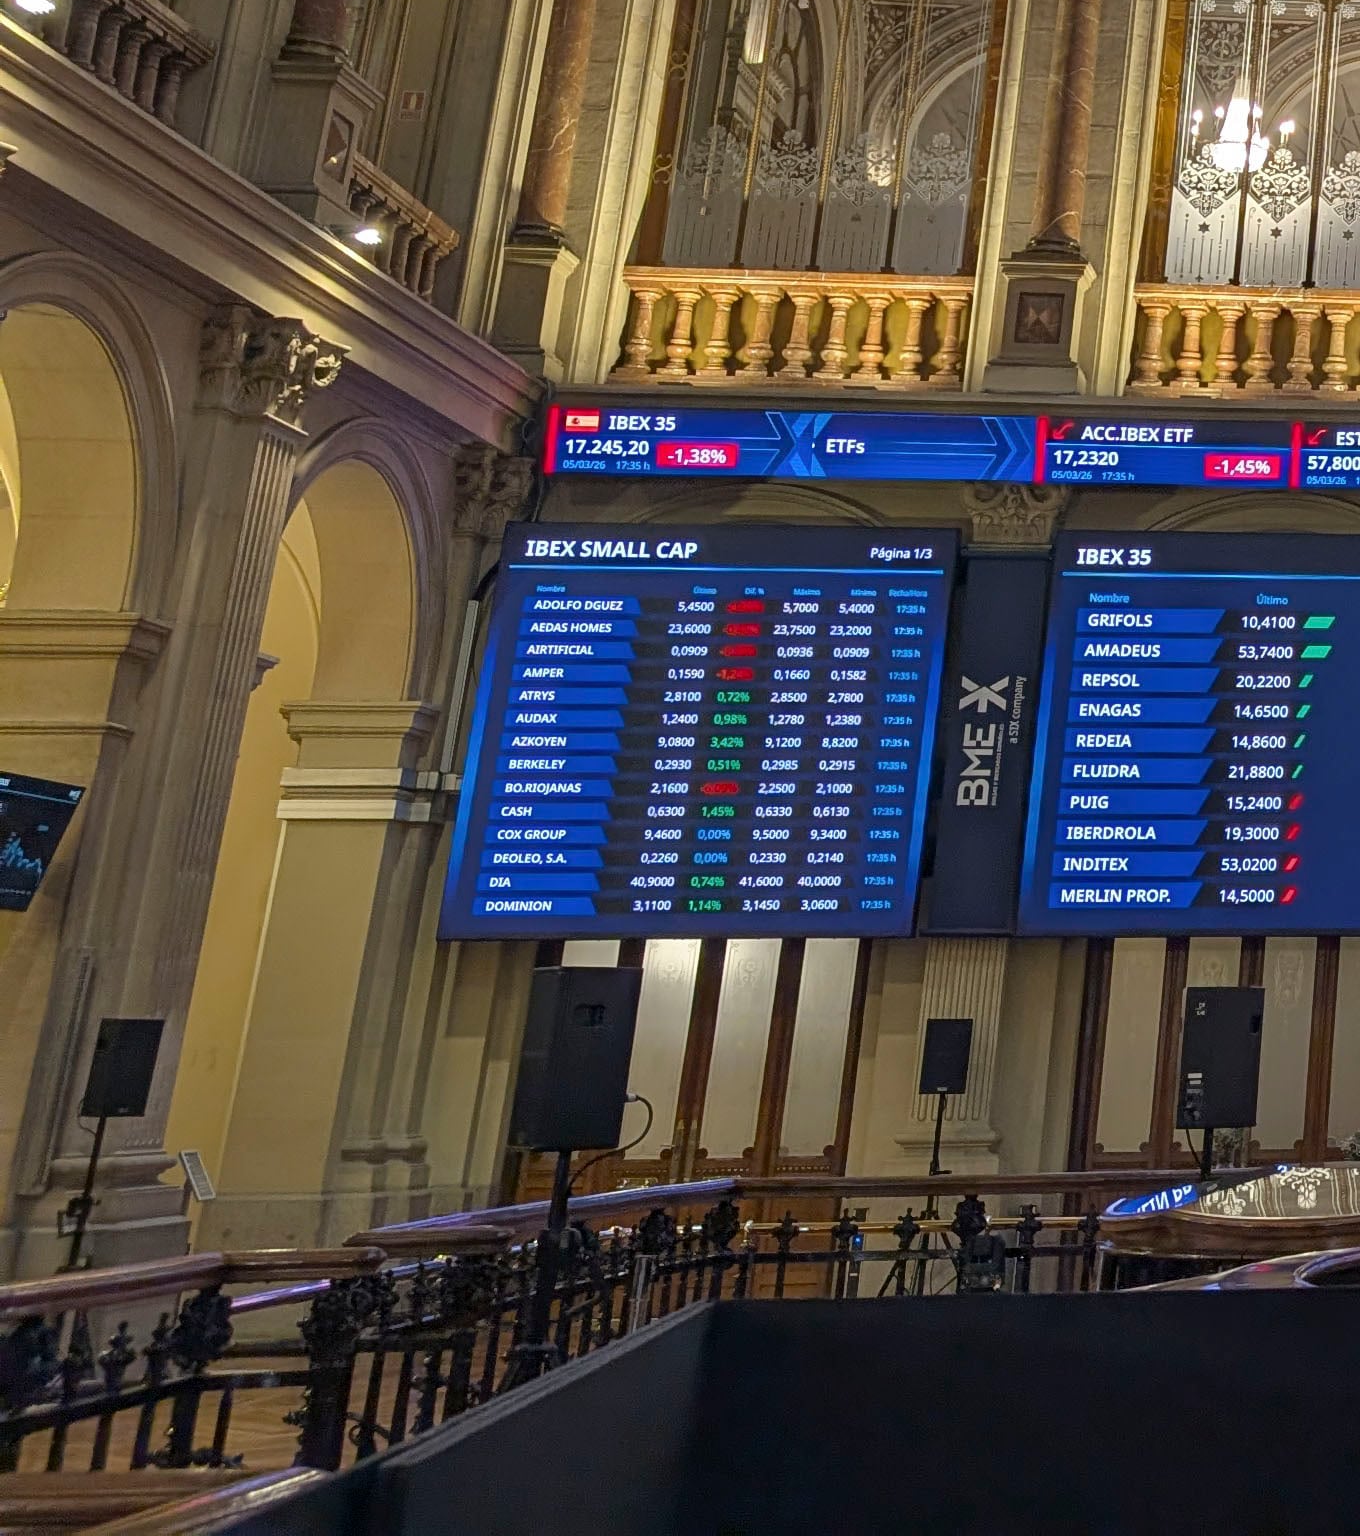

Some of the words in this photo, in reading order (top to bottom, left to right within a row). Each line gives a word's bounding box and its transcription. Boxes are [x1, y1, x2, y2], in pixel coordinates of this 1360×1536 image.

[609, 416, 651, 430] IBEX
[654, 417, 675, 431] 35
[1079, 426, 1160, 445] ACC.IBEX
[1164, 428, 1193, 442] ETF
[566, 440, 649, 456] 17.245,20
[668, 449, 726, 465] -1,38%
[826, 439, 864, 453] ETFs
[1054, 450, 1118, 466] 17,2320
[1215, 460, 1270, 475] -1,45%
[525, 540, 576, 557] IBEX
[580, 541, 650, 558] SMALL
[657, 542, 697, 558] CAP
[871, 547, 910, 561] Página
[914, 549, 932, 559] 1/3
[1077, 549, 1124, 565] IBEX
[1128, 549, 1151, 565] 35
[534, 600, 581, 610] ADOLFO
[584, 601, 623, 610] DGUEZ
[1090, 593, 1129, 603] Nombre
[1257, 594, 1288, 604] Último
[530, 623, 568, 632] AEDAS
[571, 623, 612, 632] HOMES
[1088, 614, 1152, 627] GRIFOLS
[1242, 616, 1295, 630] 10,4100
[527, 645, 593, 655] AIRTIFICIAL
[1084, 644, 1160, 657] AMADEUS
[1239, 646, 1293, 660] 53,7400
[523, 668, 563, 677] AMPER
[1082, 674, 1139, 686] REPSOL
[1236, 676, 1290, 689] 20,2200
[519, 691, 555, 700] ATRYS
[1012, 676, 1026, 719] company
[516, 714, 557, 723] AUDAX
[1080, 704, 1141, 716] ENAGAS
[1235, 705, 1288, 719] 14,6500
[512, 737, 566, 746] AZKOYEN
[1076, 735, 1131, 747] REDEIA
[1233, 736, 1286, 750] 14,8600
[509, 760, 566, 769] BERKELEY
[1074, 765, 1140, 777] FLUIDRA
[1229, 766, 1283, 780] 21,8800
[505, 783, 581, 795] BO.RIOJANAS
[1071, 796, 1108, 809] PUIG
[1228, 797, 1281, 811] 15,2400
[501, 807, 532, 816] CASH
[498, 830, 522, 839] COX
[525, 830, 566, 839] GROUP
[1067, 827, 1156, 839] IBERDROLA
[1225, 827, 1279, 841] 19,3000
[494, 854, 542, 864] DEOLEO,
[546, 854, 566, 863] S.A.
[1064, 858, 1128, 871] INDITEX
[1222, 859, 1276, 872] 53,0200
[490, 877, 510, 887] DIA
[1061, 889, 1122, 902] MERLIN
[1127, 889, 1170, 902] PROP.
[1220, 890, 1274, 904] 14,5000
[486, 901, 552, 911] DOMINION
